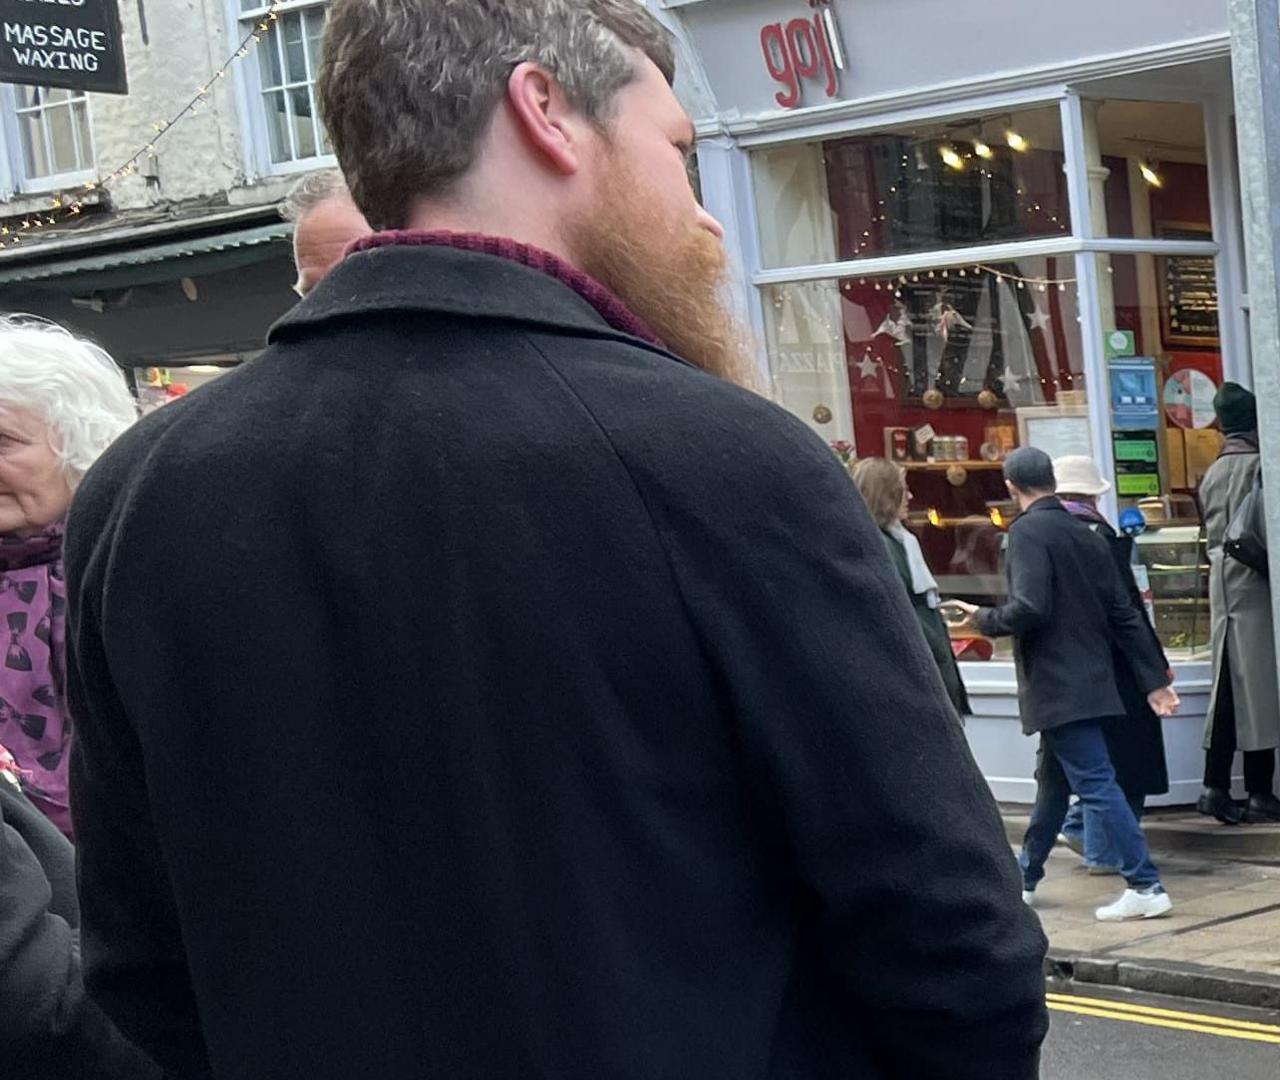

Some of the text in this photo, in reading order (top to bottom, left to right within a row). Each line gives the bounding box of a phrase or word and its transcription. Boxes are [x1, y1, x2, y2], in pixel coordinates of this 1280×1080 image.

[4, 22, 106, 51] MASSAGE
[12, 47, 98, 71] WAXING
[760, 0, 844, 108] goji
